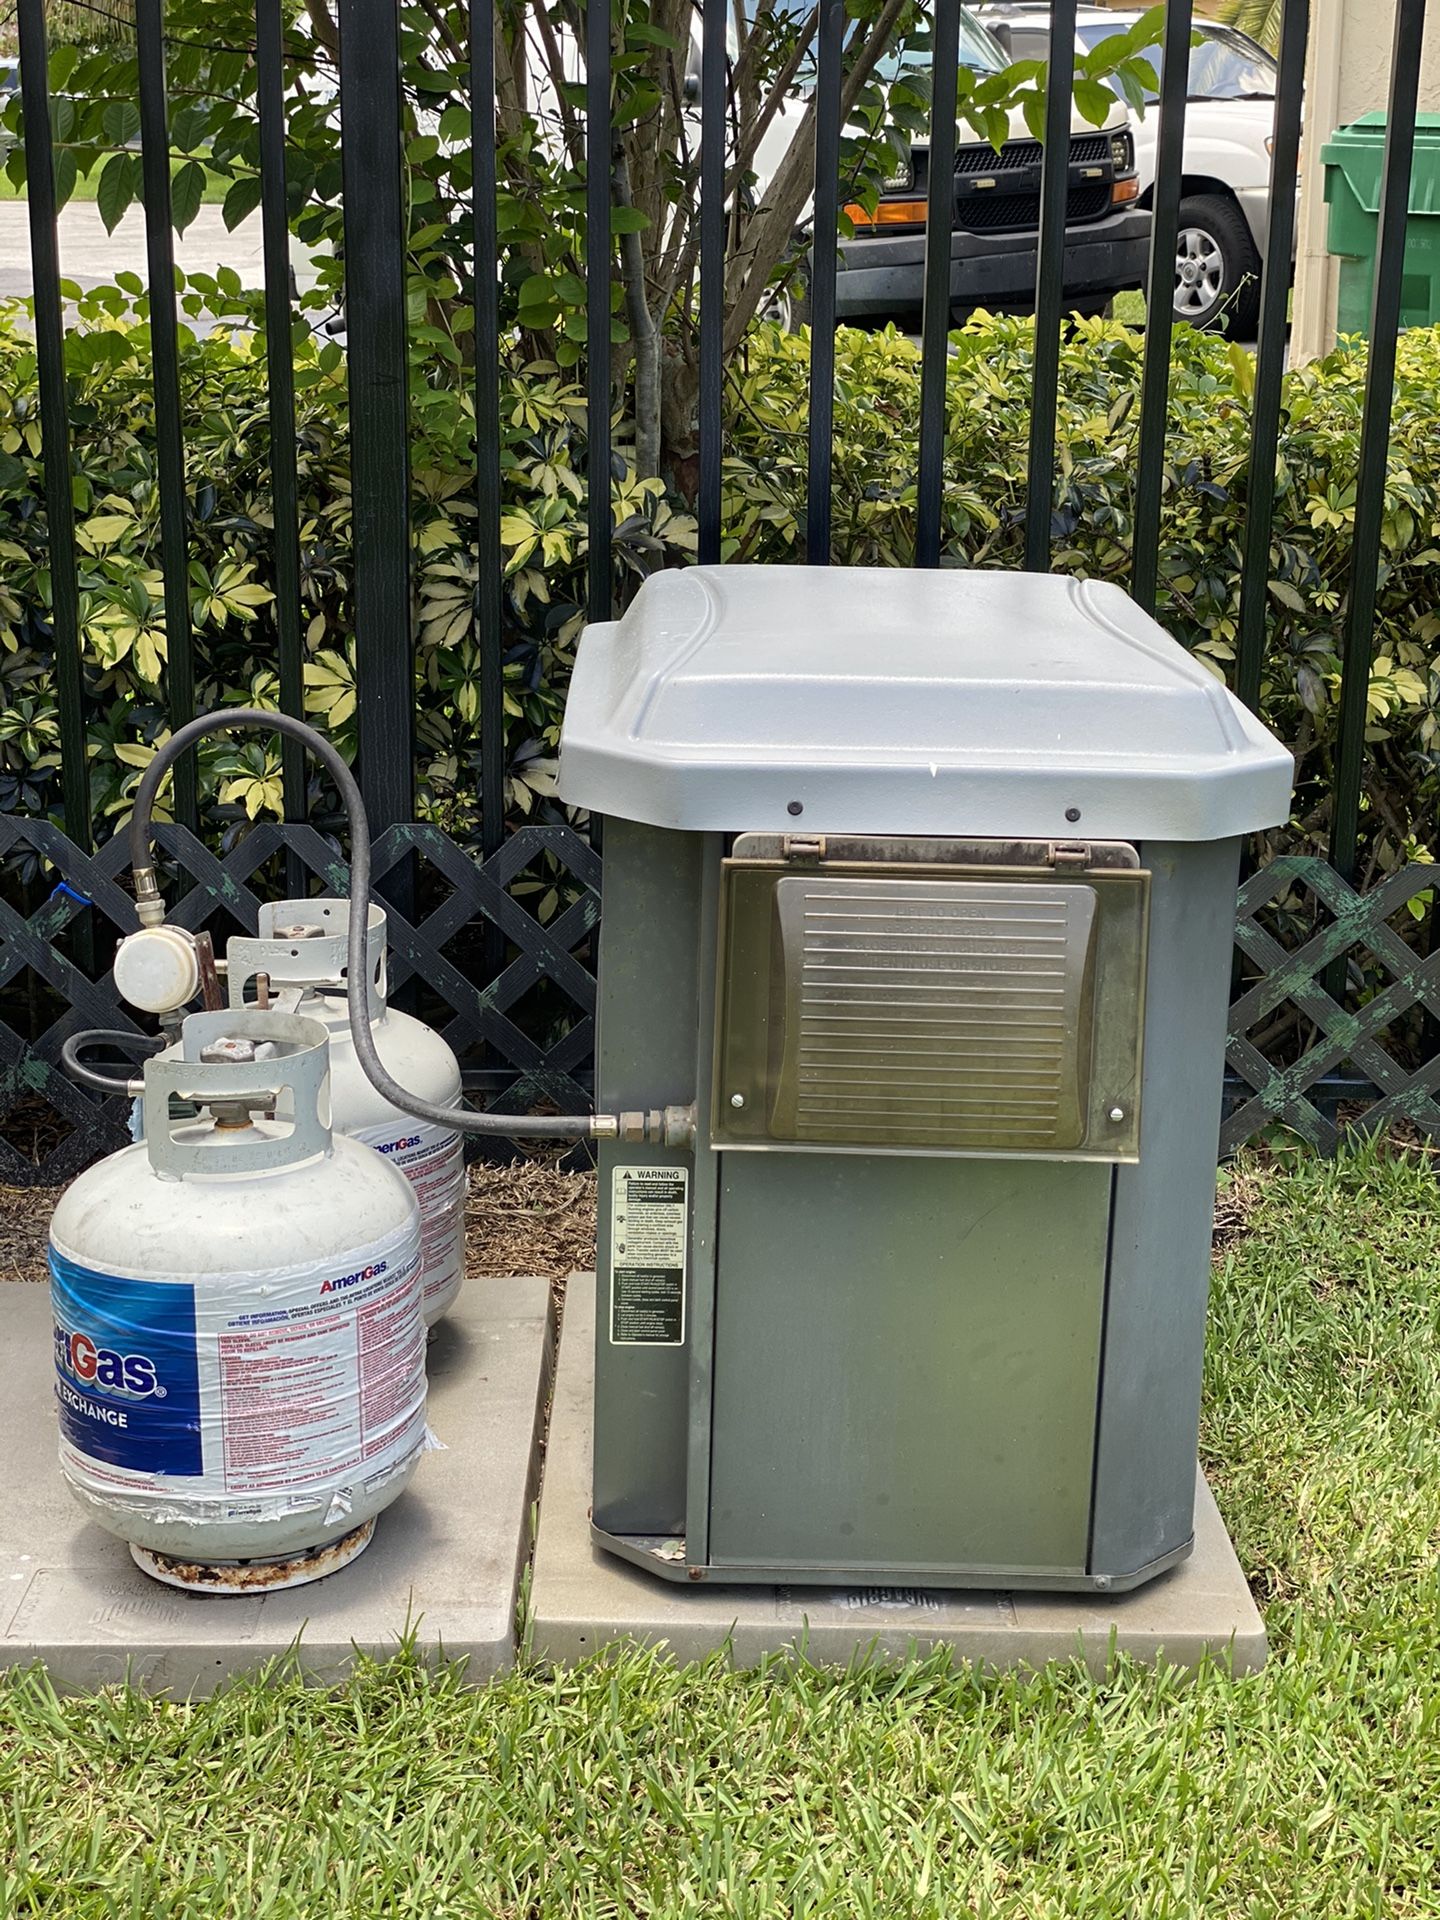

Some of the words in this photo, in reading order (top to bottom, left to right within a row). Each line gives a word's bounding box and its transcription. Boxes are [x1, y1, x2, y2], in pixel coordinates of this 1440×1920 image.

[373, 1135, 420, 1153] eriGas
[638, 1171, 679, 1179] WARNING
[319, 1261, 387, 1295] AmeriGas
[63, 1385, 128, 1428] EXCHANGE
